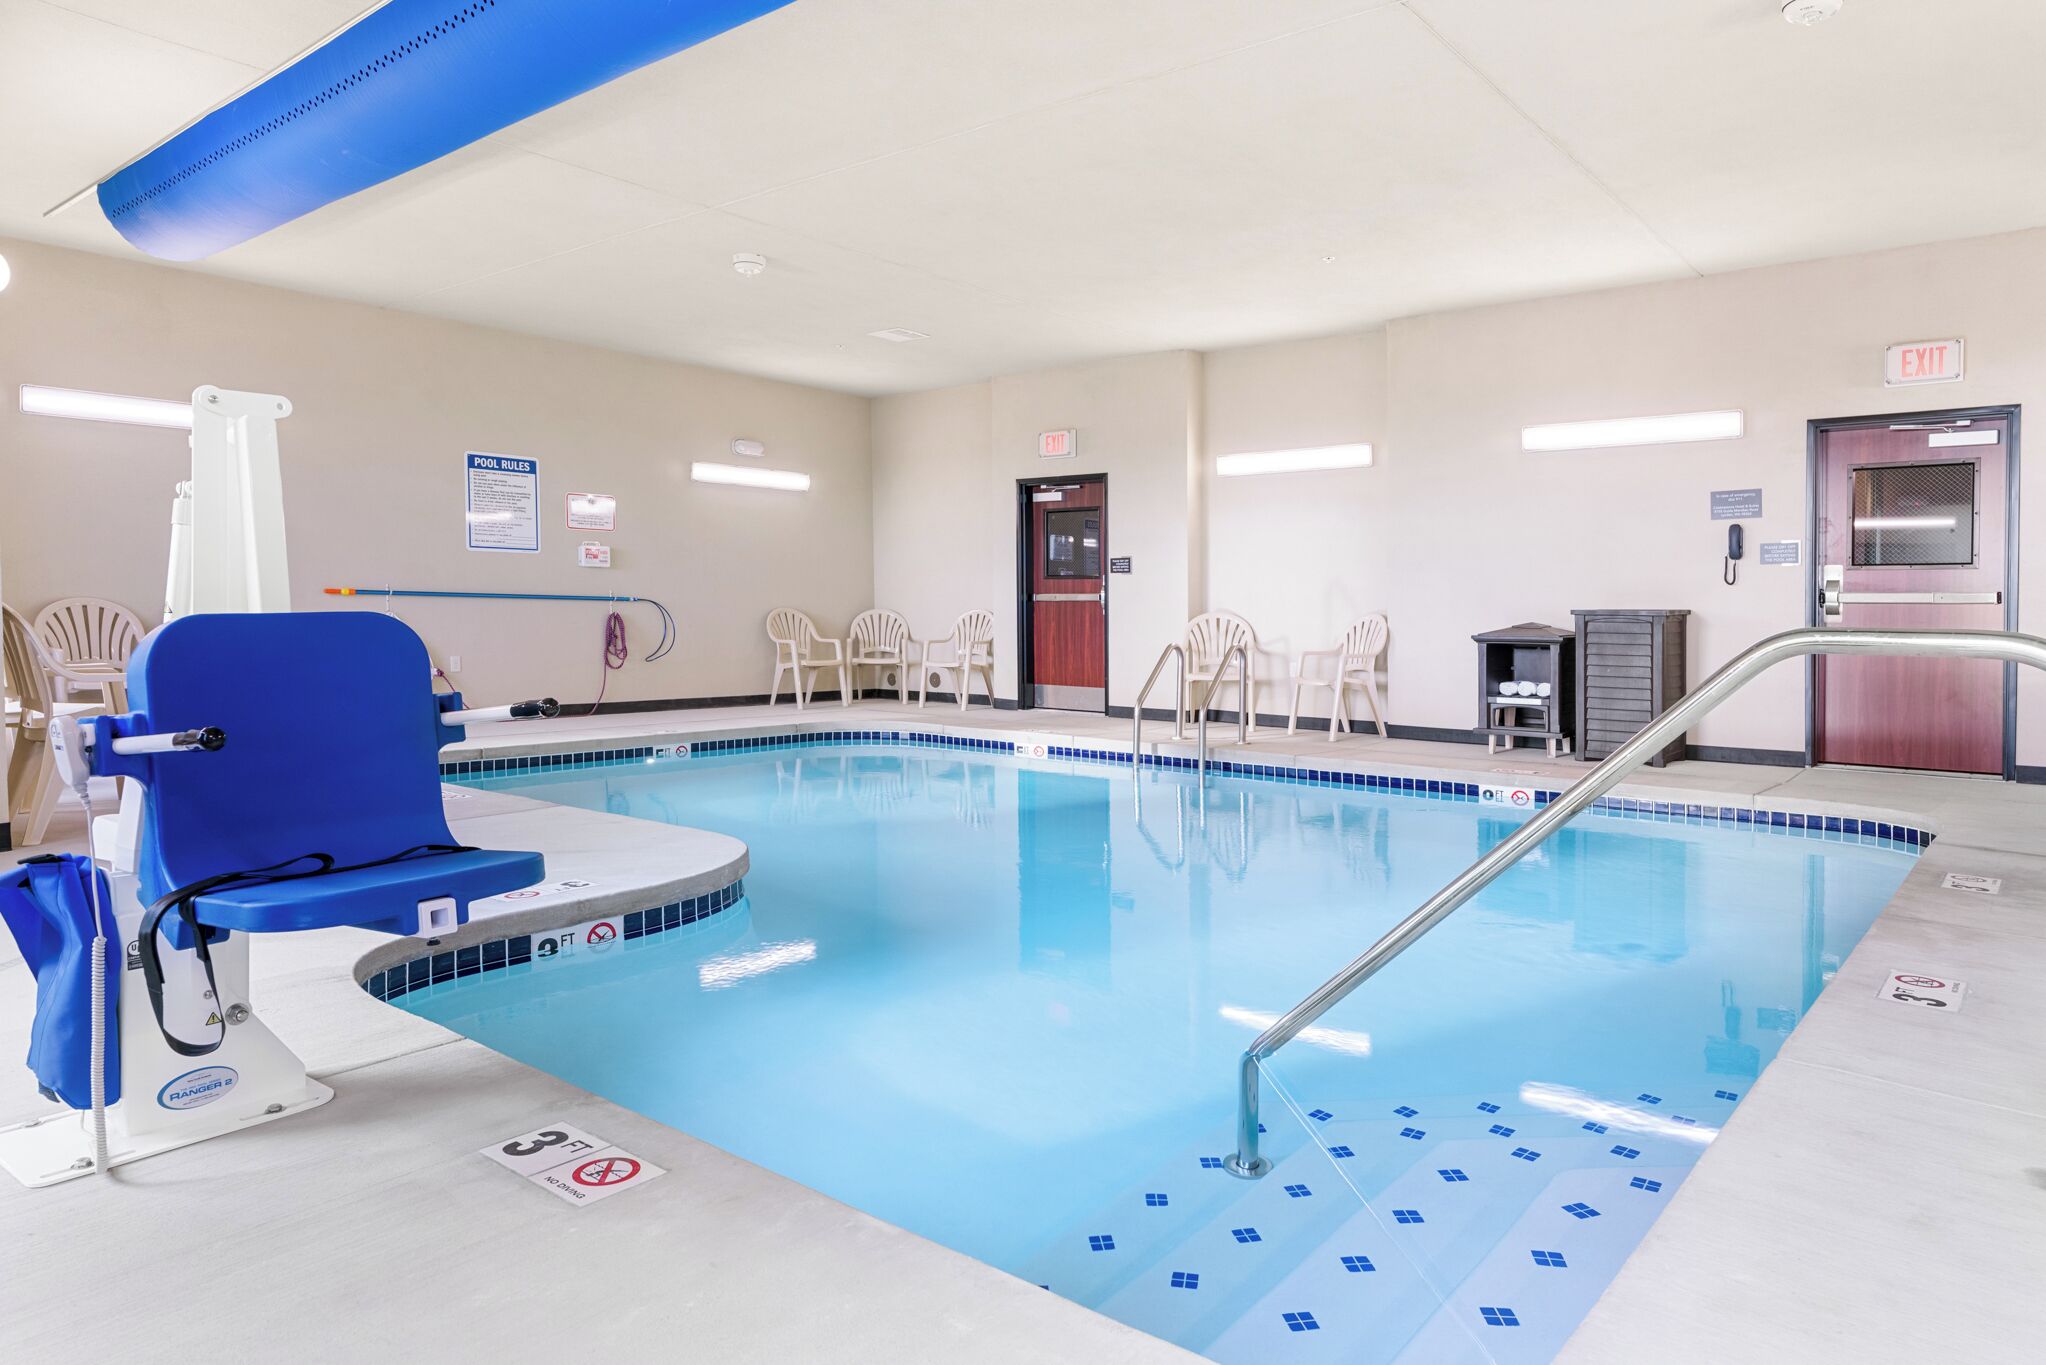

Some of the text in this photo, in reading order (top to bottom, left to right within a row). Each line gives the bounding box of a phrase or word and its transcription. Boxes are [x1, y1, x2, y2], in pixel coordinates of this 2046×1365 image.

[1901, 346, 1947, 377] EXIT
[1045, 433, 1065, 453] EXIT
[474, 457, 530, 472] POOL RULES
[560, 932, 575, 946] FT
[1892, 993, 1948, 1008] 3
[169, 1081, 222, 1102] RANGER
[224, 1078, 233, 1086] 2
[502, 1130, 595, 1157] 3 FT
[544, 1176, 586, 1200] NO DIVING
